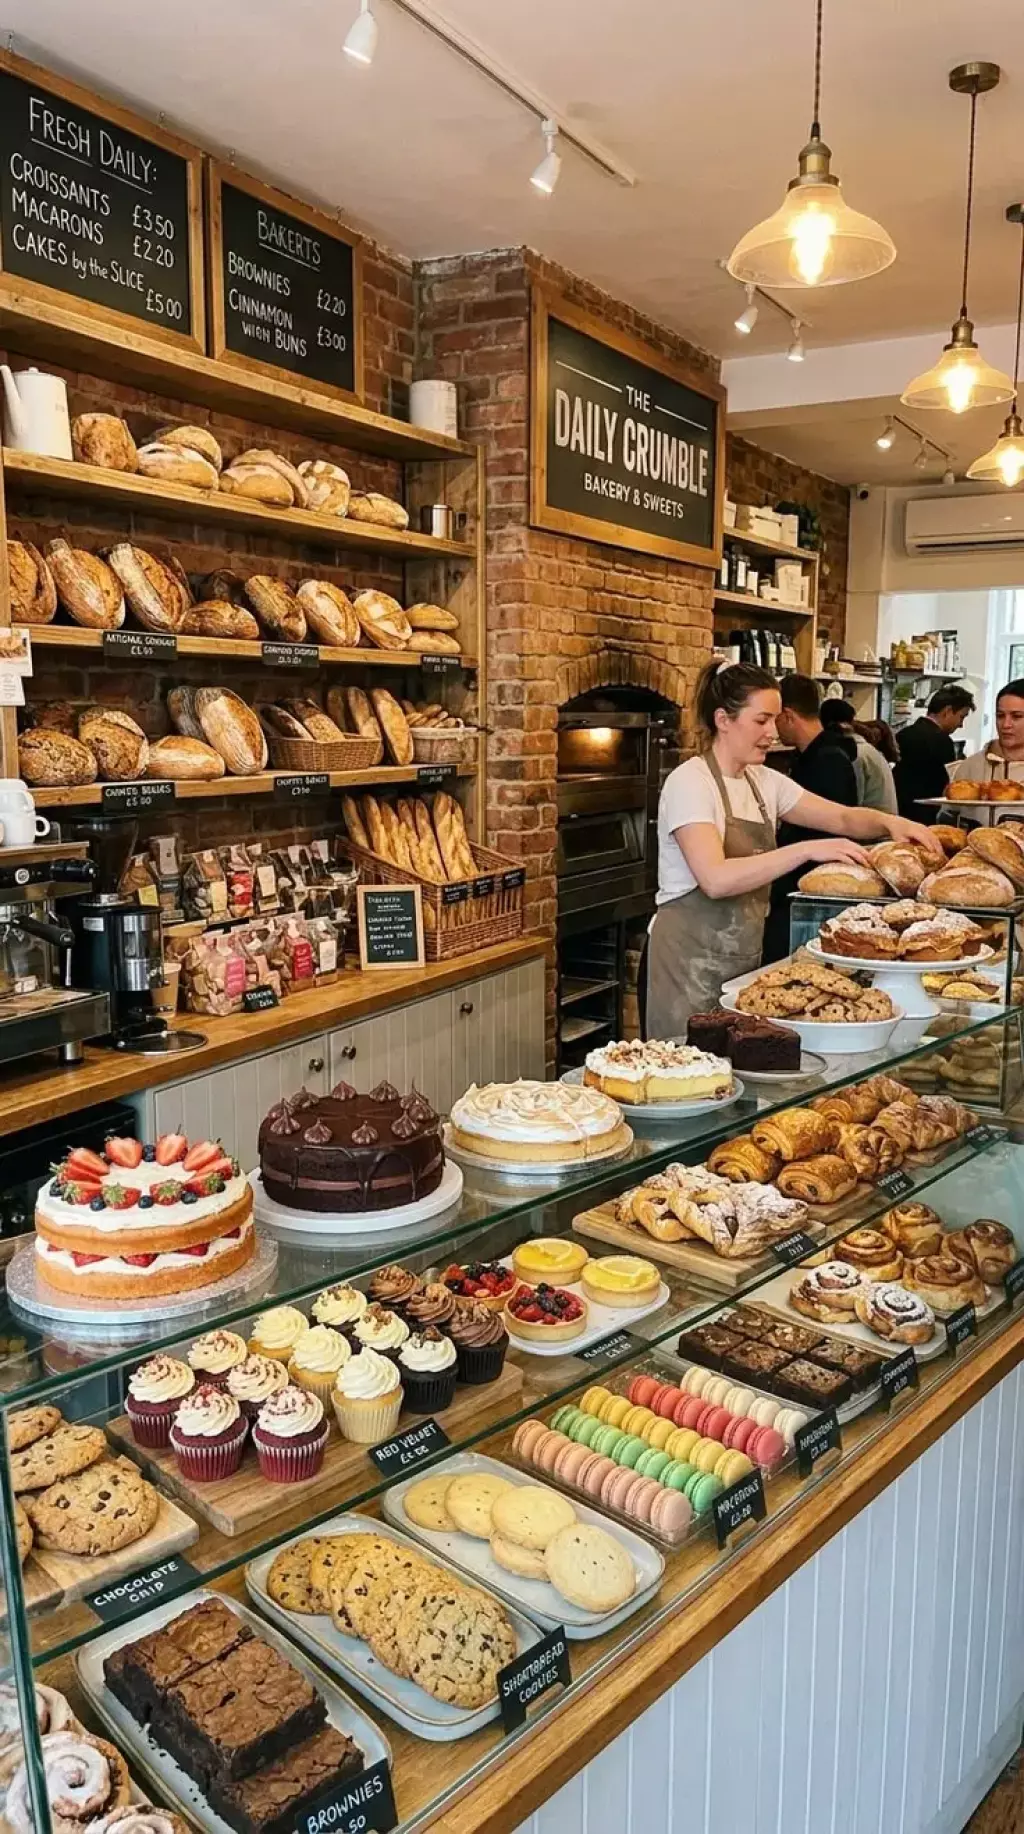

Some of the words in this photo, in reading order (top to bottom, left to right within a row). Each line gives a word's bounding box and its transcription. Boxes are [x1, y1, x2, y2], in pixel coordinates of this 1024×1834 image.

[30, 97, 91, 157] FRESH
[100, 130, 157, 183] DAILY:
[10, 153, 111, 216] CROISSANTS
[11, 187, 104, 245] MACARONS
[257, 210, 321, 264] BAKERTS
[13, 223, 68, 265] CAKES
[72, 250, 87, 279] by
[89, 257, 108, 279] the
[110, 260, 145, 292] SLICE
[228, 251, 291, 296] BROWNIES
[229, 288, 293, 330] CINNAMON
[275, 328, 307, 357] BUNS
[625, 384, 651, 413] THE
[555, 388, 618, 464] DAILY
[622, 417, 709, 497] CRUMBLE
[584, 472, 630, 503] BAKERY
[632, 489, 641, 506] &
[643, 492, 684, 519] SWEETS
[306, 1774, 384, 1834] BROWNIES
